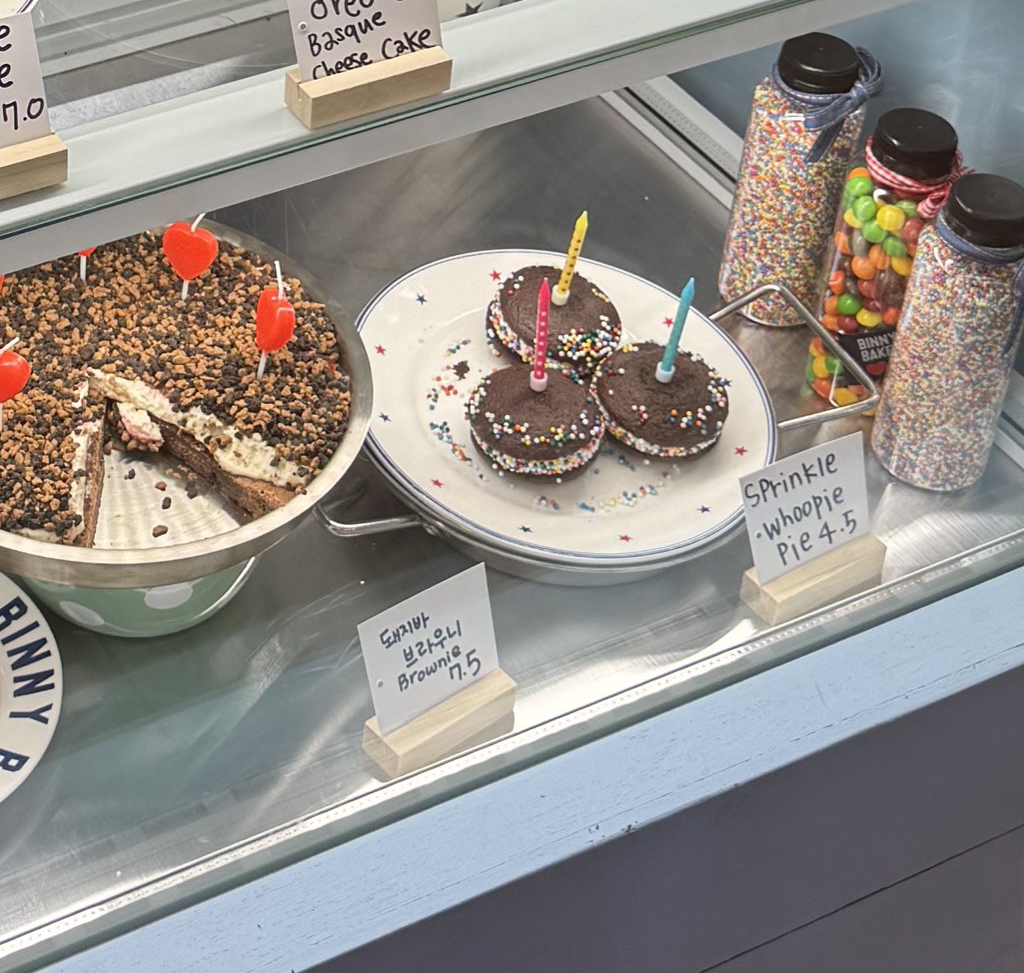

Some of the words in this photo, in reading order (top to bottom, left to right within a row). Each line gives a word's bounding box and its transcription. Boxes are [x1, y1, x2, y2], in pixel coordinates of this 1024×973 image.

[308, 11, 386, 57] Basque
[312, 52, 373, 80] Cheese
[381, 28, 433, 60] Cake
[2, 97, 45, 131] 7.0
[776, 530, 813, 566] Pie
[818, 509, 858, 544] 4.5
[403, 619, 462, 668] 브라우니
[449, 649, 482, 681] 7.5
[397, 645, 462, 692] Brownie
